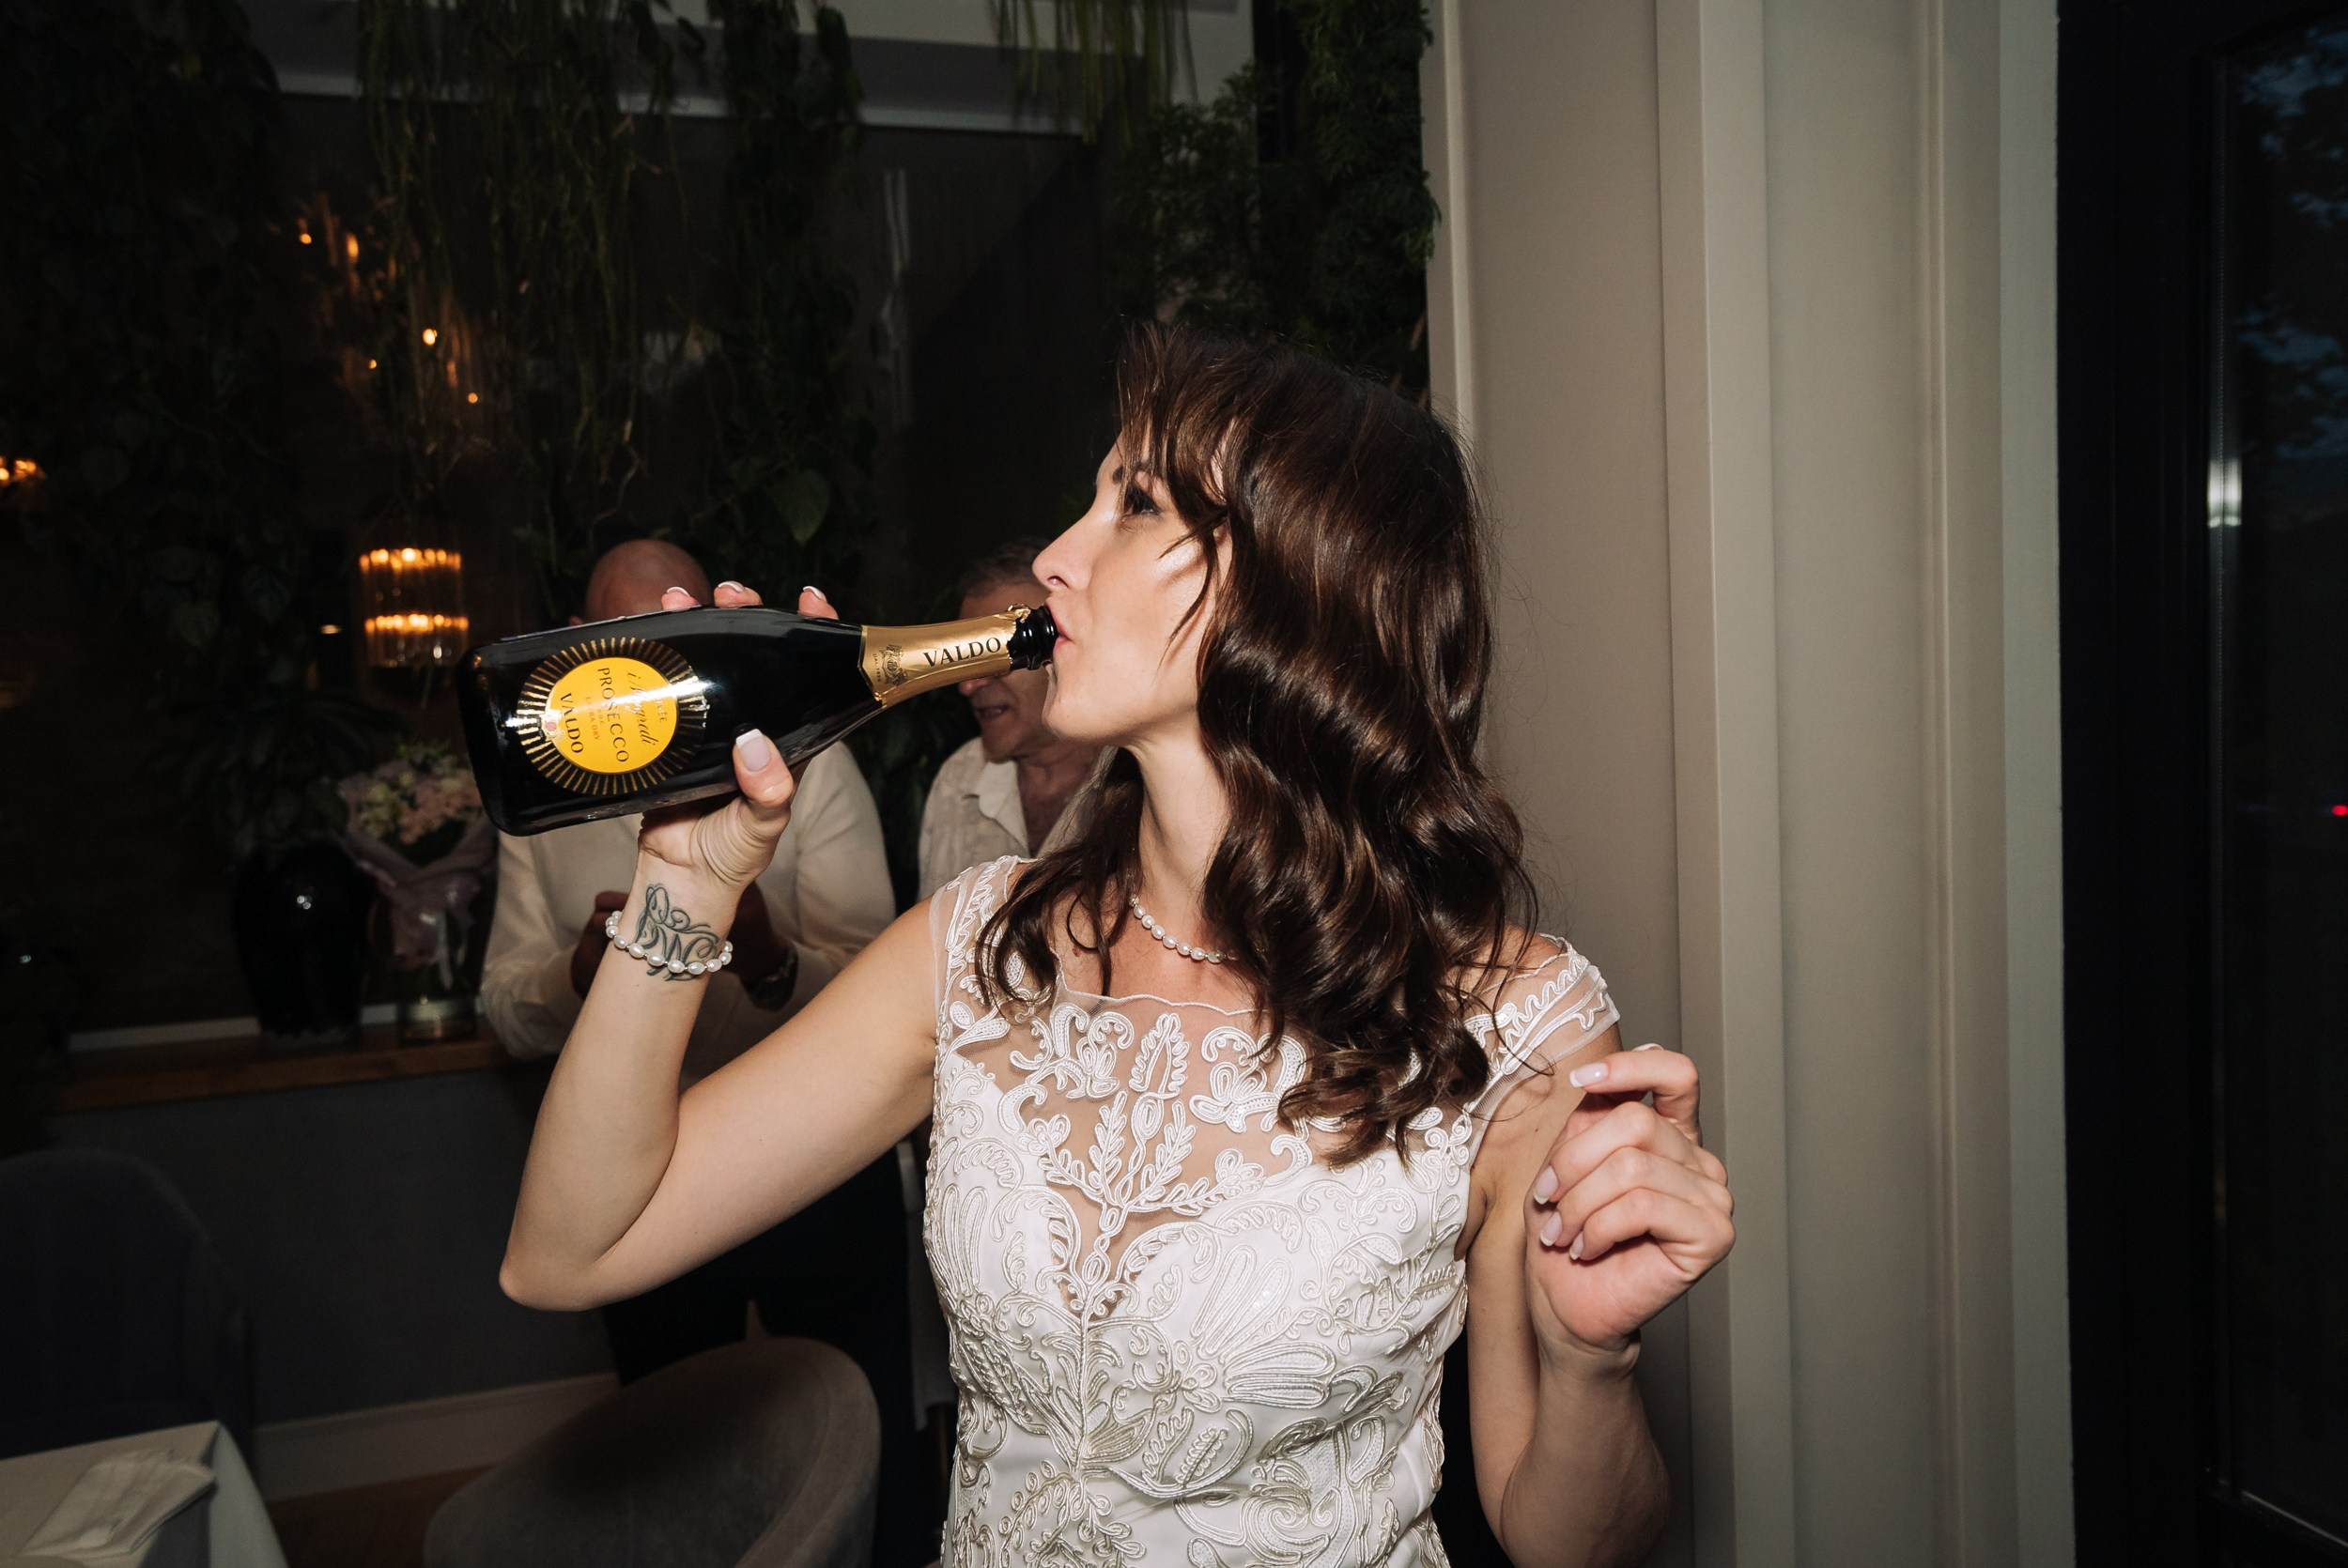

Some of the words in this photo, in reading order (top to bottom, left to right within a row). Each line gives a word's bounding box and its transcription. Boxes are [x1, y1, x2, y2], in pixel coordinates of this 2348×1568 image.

[922, 637, 1002, 668] VALDO
[561, 693, 583, 753] VALDO
[585, 697, 595, 723] ERA
[597, 668, 629, 762] PROSECCO
[625, 679, 659, 746] Mgredi
